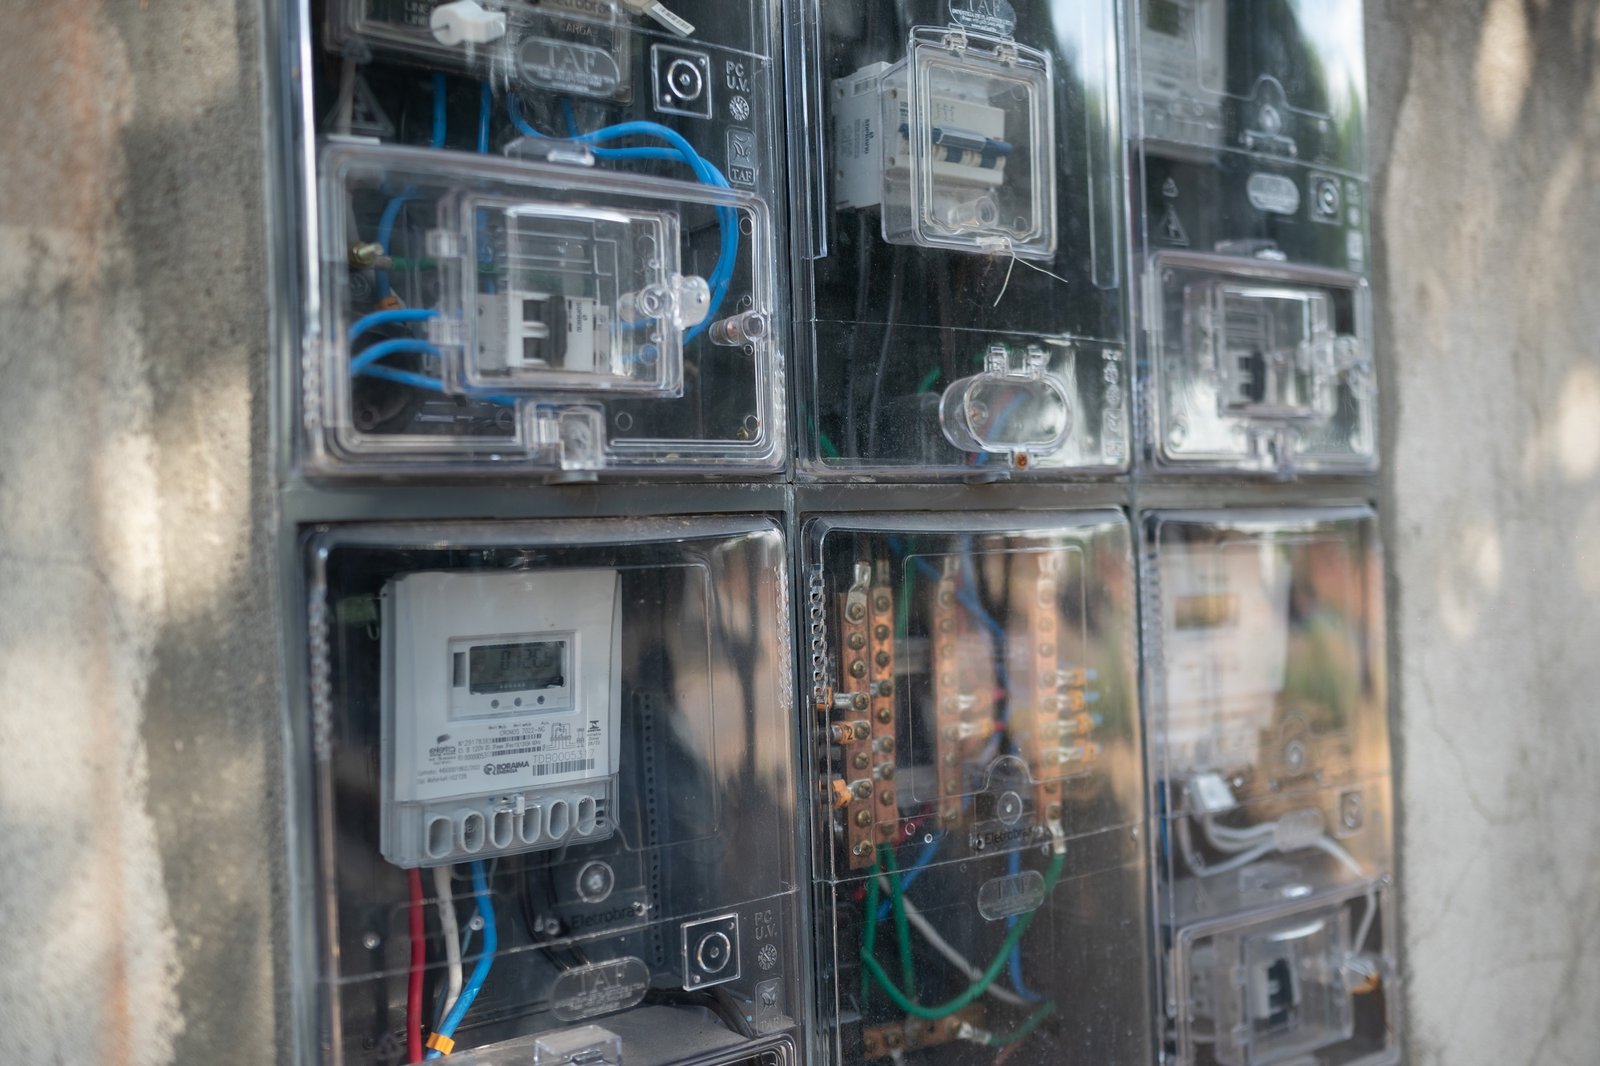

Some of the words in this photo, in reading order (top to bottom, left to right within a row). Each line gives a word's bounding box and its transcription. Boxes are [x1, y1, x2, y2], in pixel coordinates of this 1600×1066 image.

[543, 45, 598, 74] TAF
[725, 59, 744, 77] PC
[726, 74, 751, 93] U.V.
[731, 168, 752, 182] TAF
[496, 760, 530, 769] RORAIMA
[571, 905, 640, 929] Eletrobra
[754, 909, 772, 926] PC
